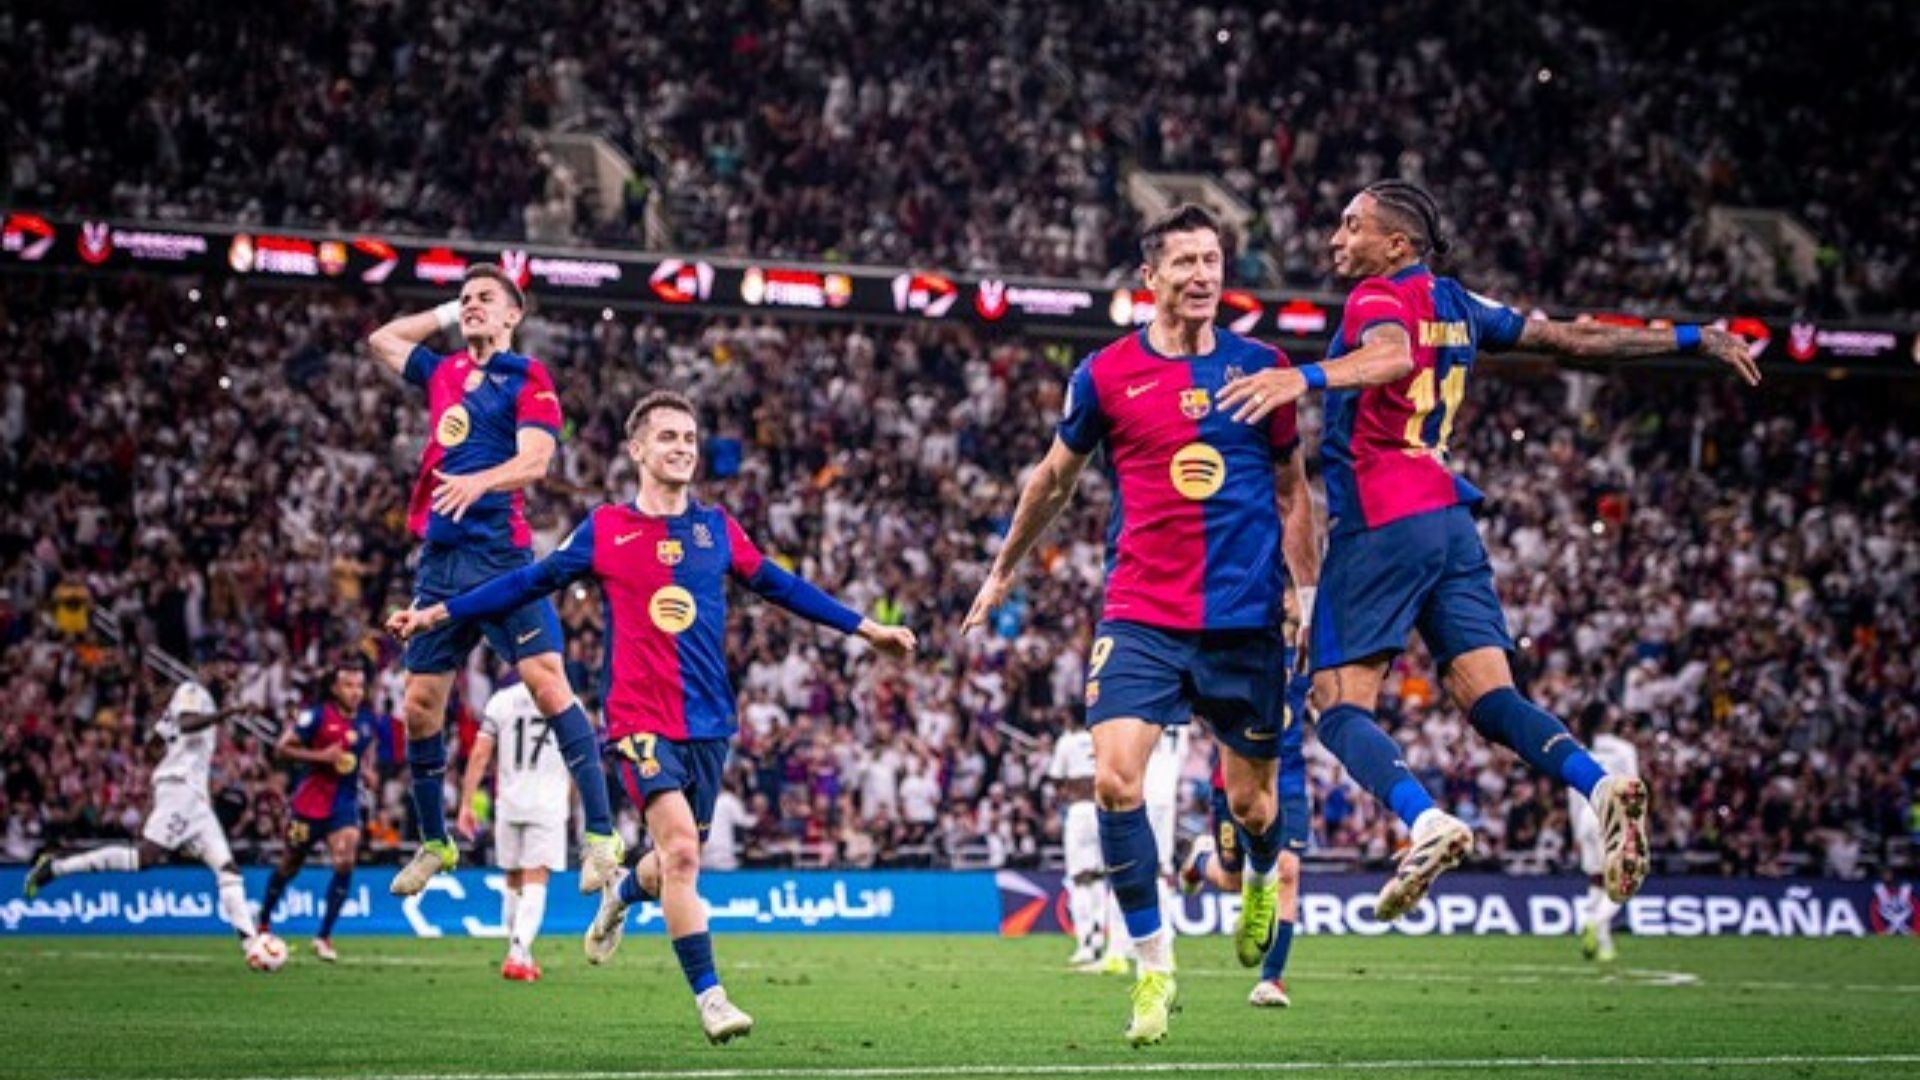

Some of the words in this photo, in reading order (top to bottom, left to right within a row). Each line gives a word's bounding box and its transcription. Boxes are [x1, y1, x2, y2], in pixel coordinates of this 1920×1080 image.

[1403, 364, 1467, 451] 11
[1089, 636, 1115, 678] 9
[514, 715, 555, 770] 17
[1627, 886, 1866, 936] ESPAÑA
